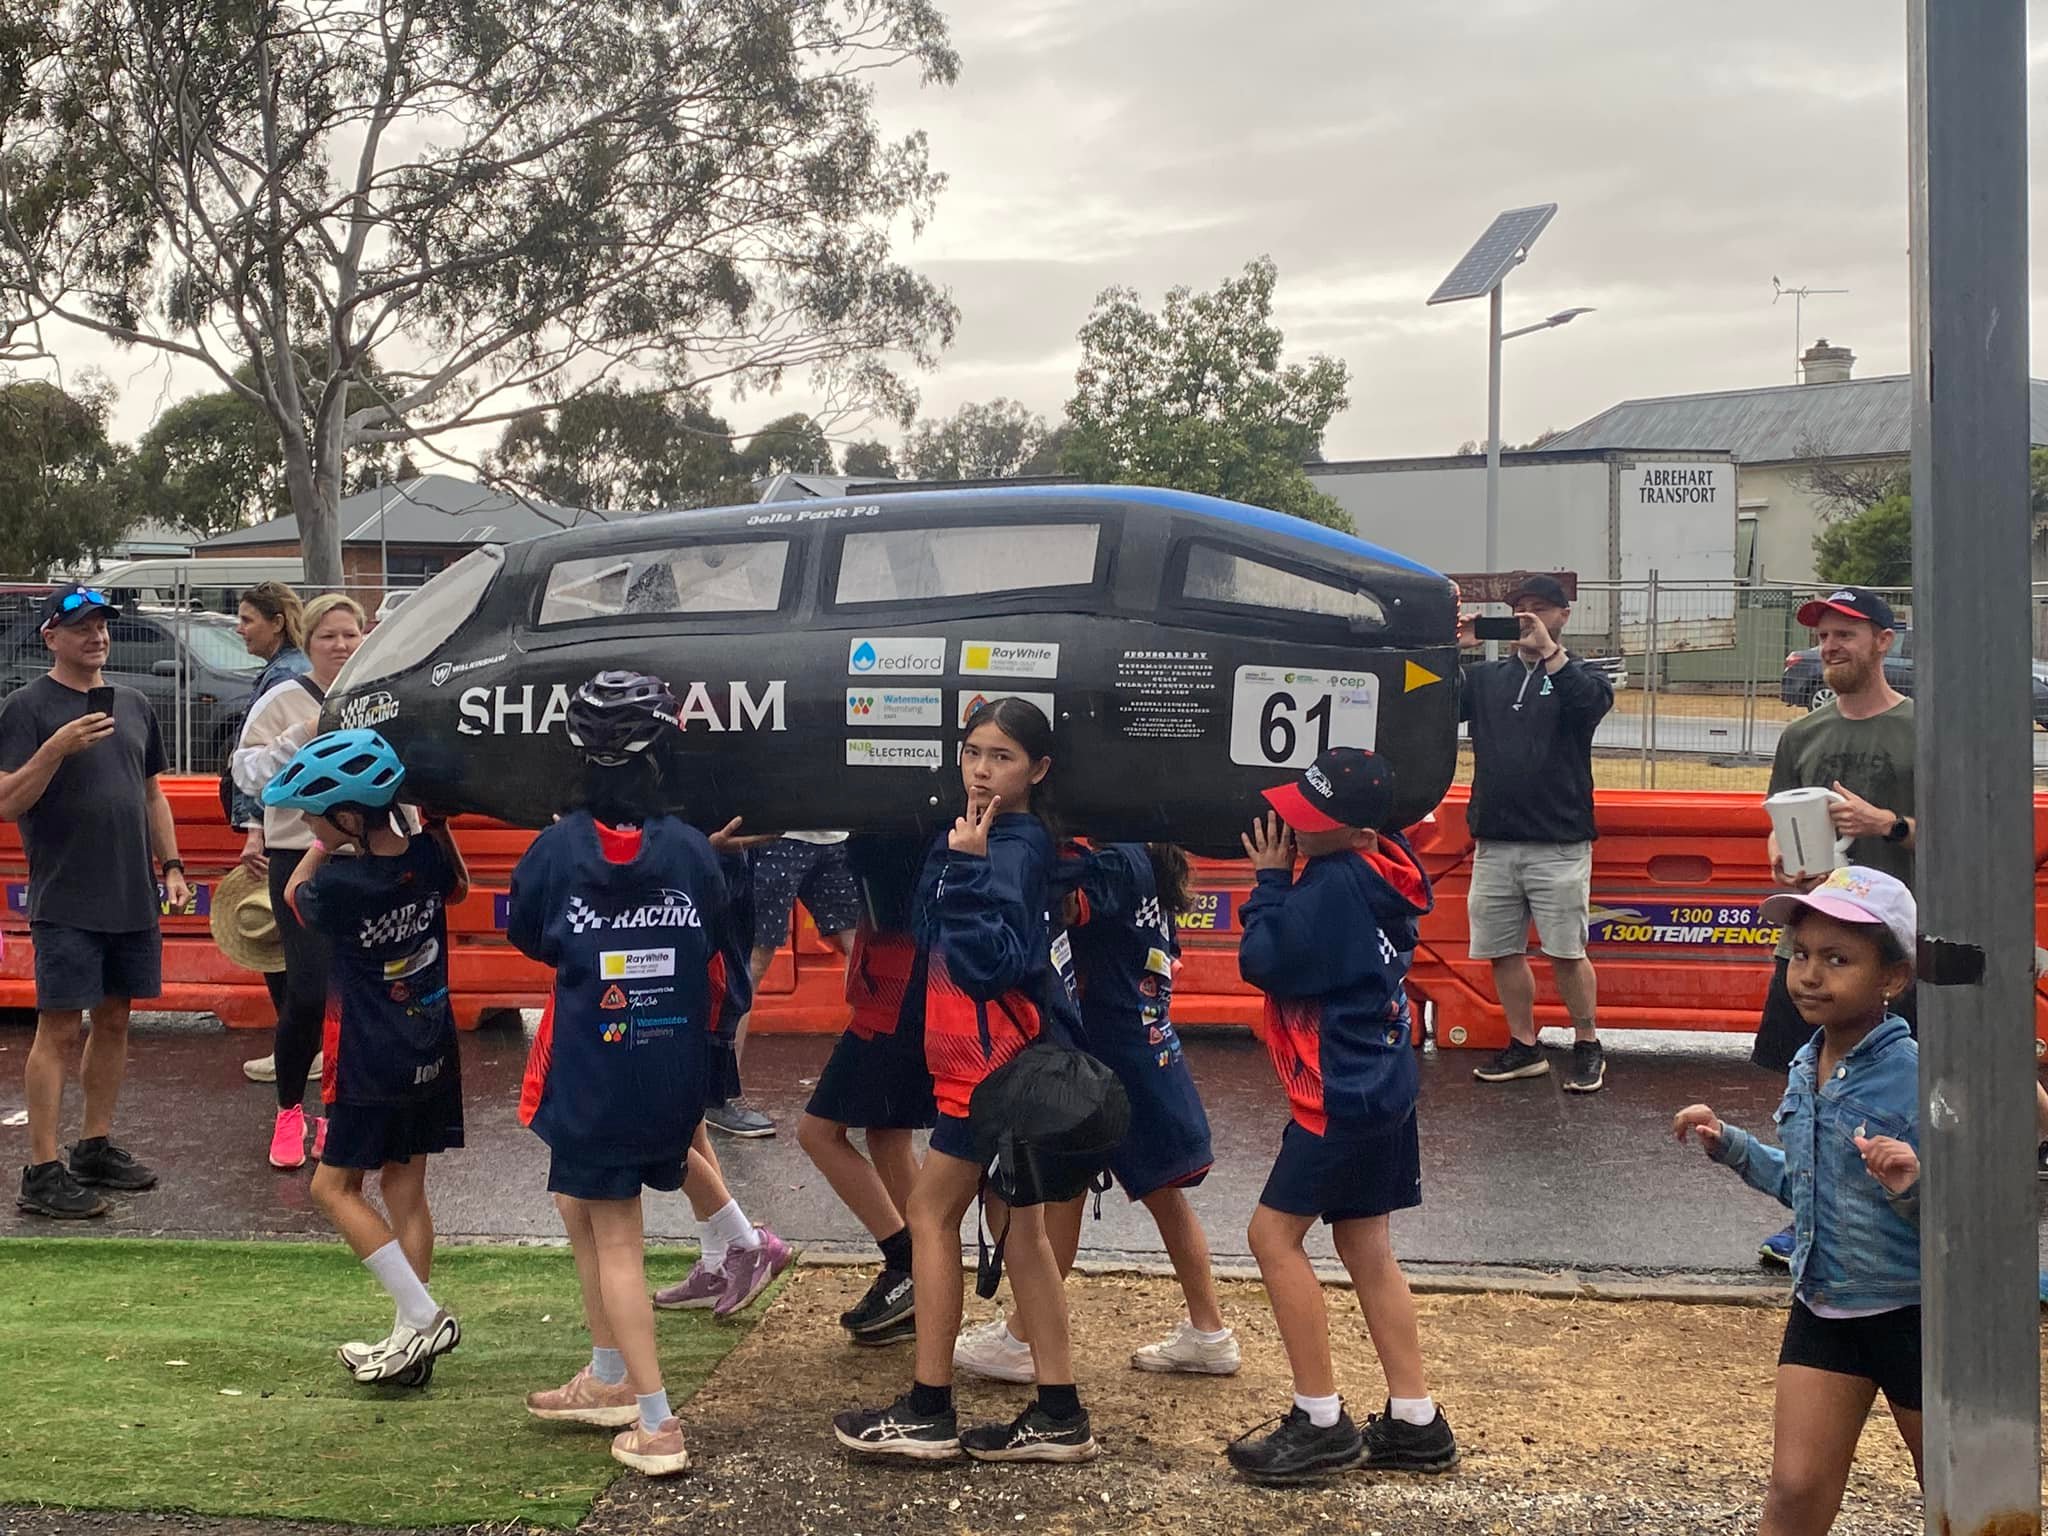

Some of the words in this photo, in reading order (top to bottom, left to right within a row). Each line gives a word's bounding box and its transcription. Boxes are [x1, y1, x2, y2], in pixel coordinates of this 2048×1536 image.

[1643, 470, 1712, 486] ABREHART
[1639, 487, 1716, 503] TRANSPORT
[797, 507, 847, 521] Park
[992, 648, 1051, 659] RayWhite
[878, 654, 941, 669] redford
[1340, 677, 1366, 688] cep
[457, 680, 786, 735] SHAAM
[1260, 692, 1332, 763] 61
[869, 747, 939, 758] ELECTRICAL
[1670, 908, 1713, 923] 1300
[1718, 909, 1751, 924] 836
